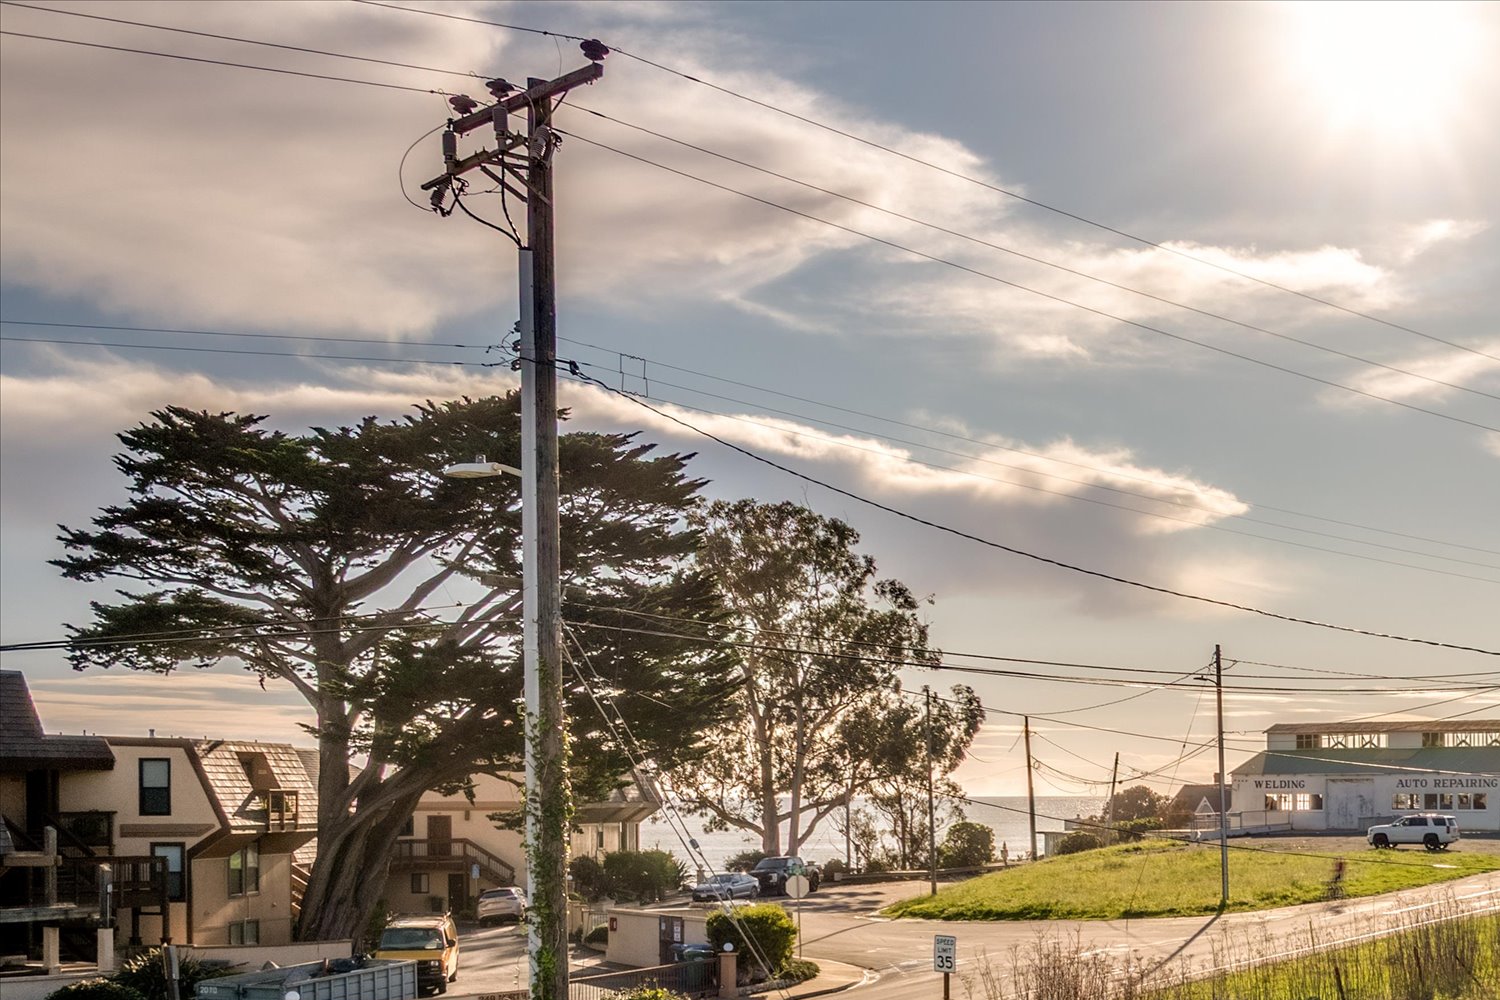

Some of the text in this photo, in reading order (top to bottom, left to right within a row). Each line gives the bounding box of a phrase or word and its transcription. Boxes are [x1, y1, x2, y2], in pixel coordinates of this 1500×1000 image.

[1254, 780, 1305, 789] WELDING
[1396, 779, 1498, 788] AUTO REPAIRING
[936, 938, 954, 946] SPEED
[937, 955, 953, 969] 35
